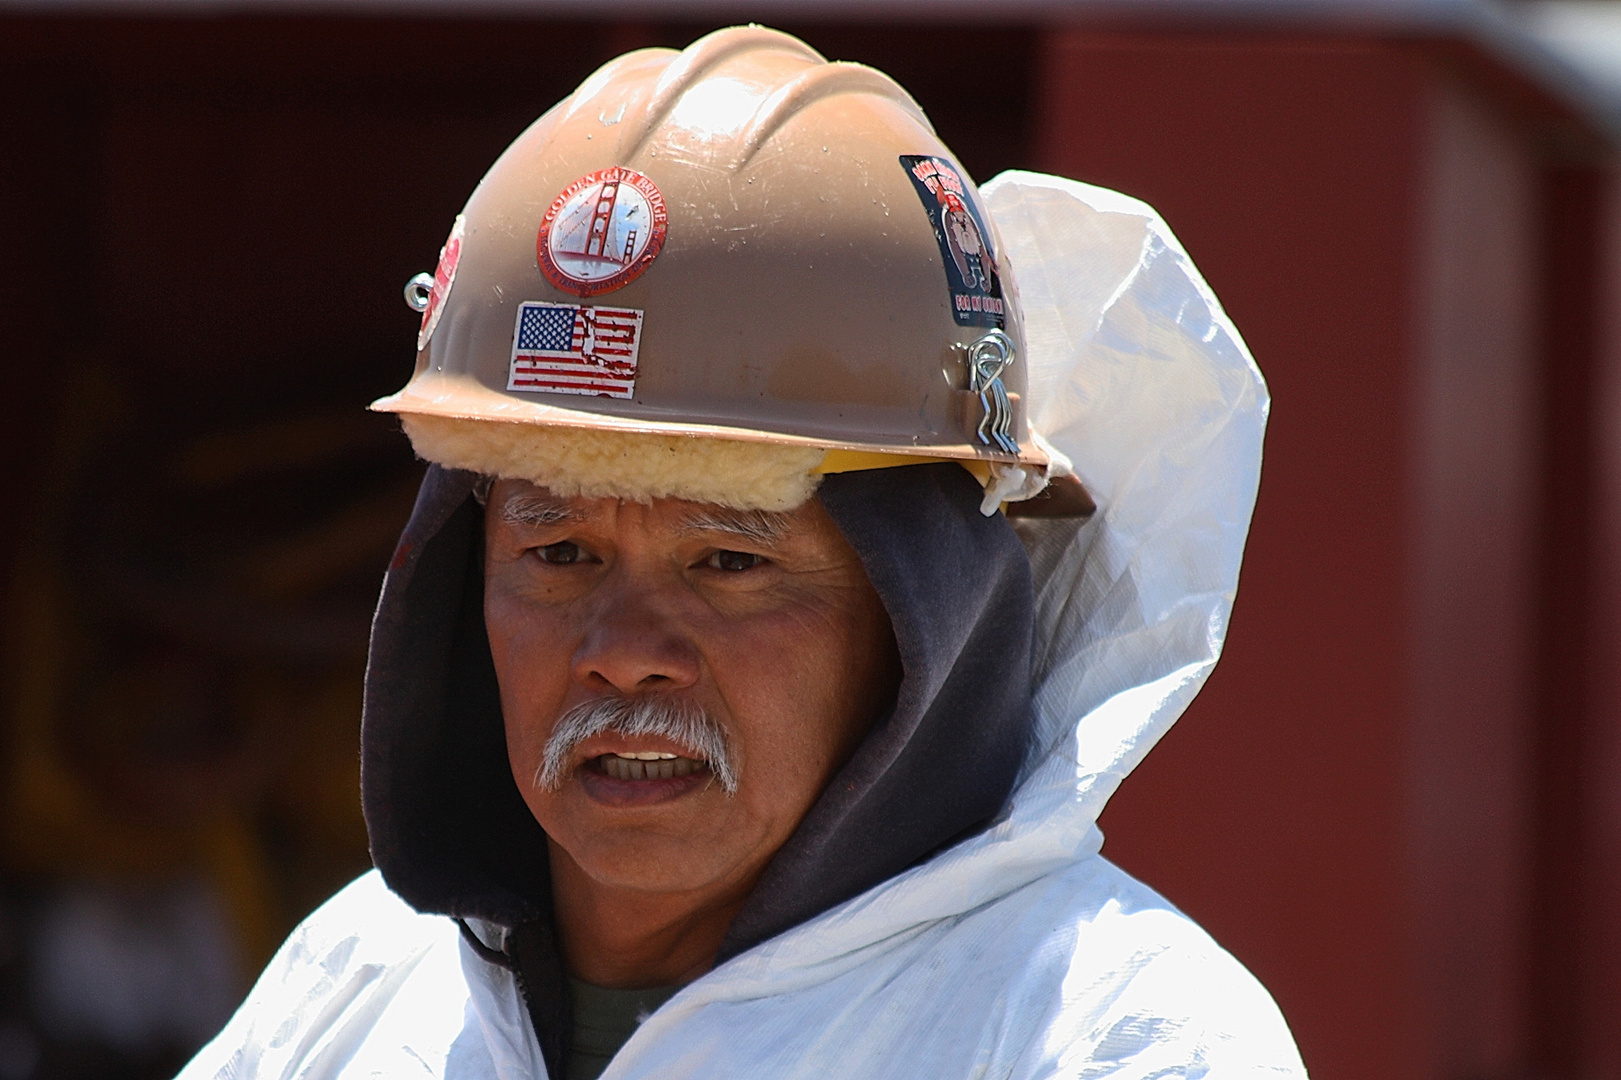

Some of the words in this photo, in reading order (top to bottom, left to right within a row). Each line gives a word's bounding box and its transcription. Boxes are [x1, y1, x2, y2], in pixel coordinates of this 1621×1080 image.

[545, 174, 596, 221] GOLDEN
[599, 169, 637, 182] GATE
[636, 177, 667, 223] BRIDGE
